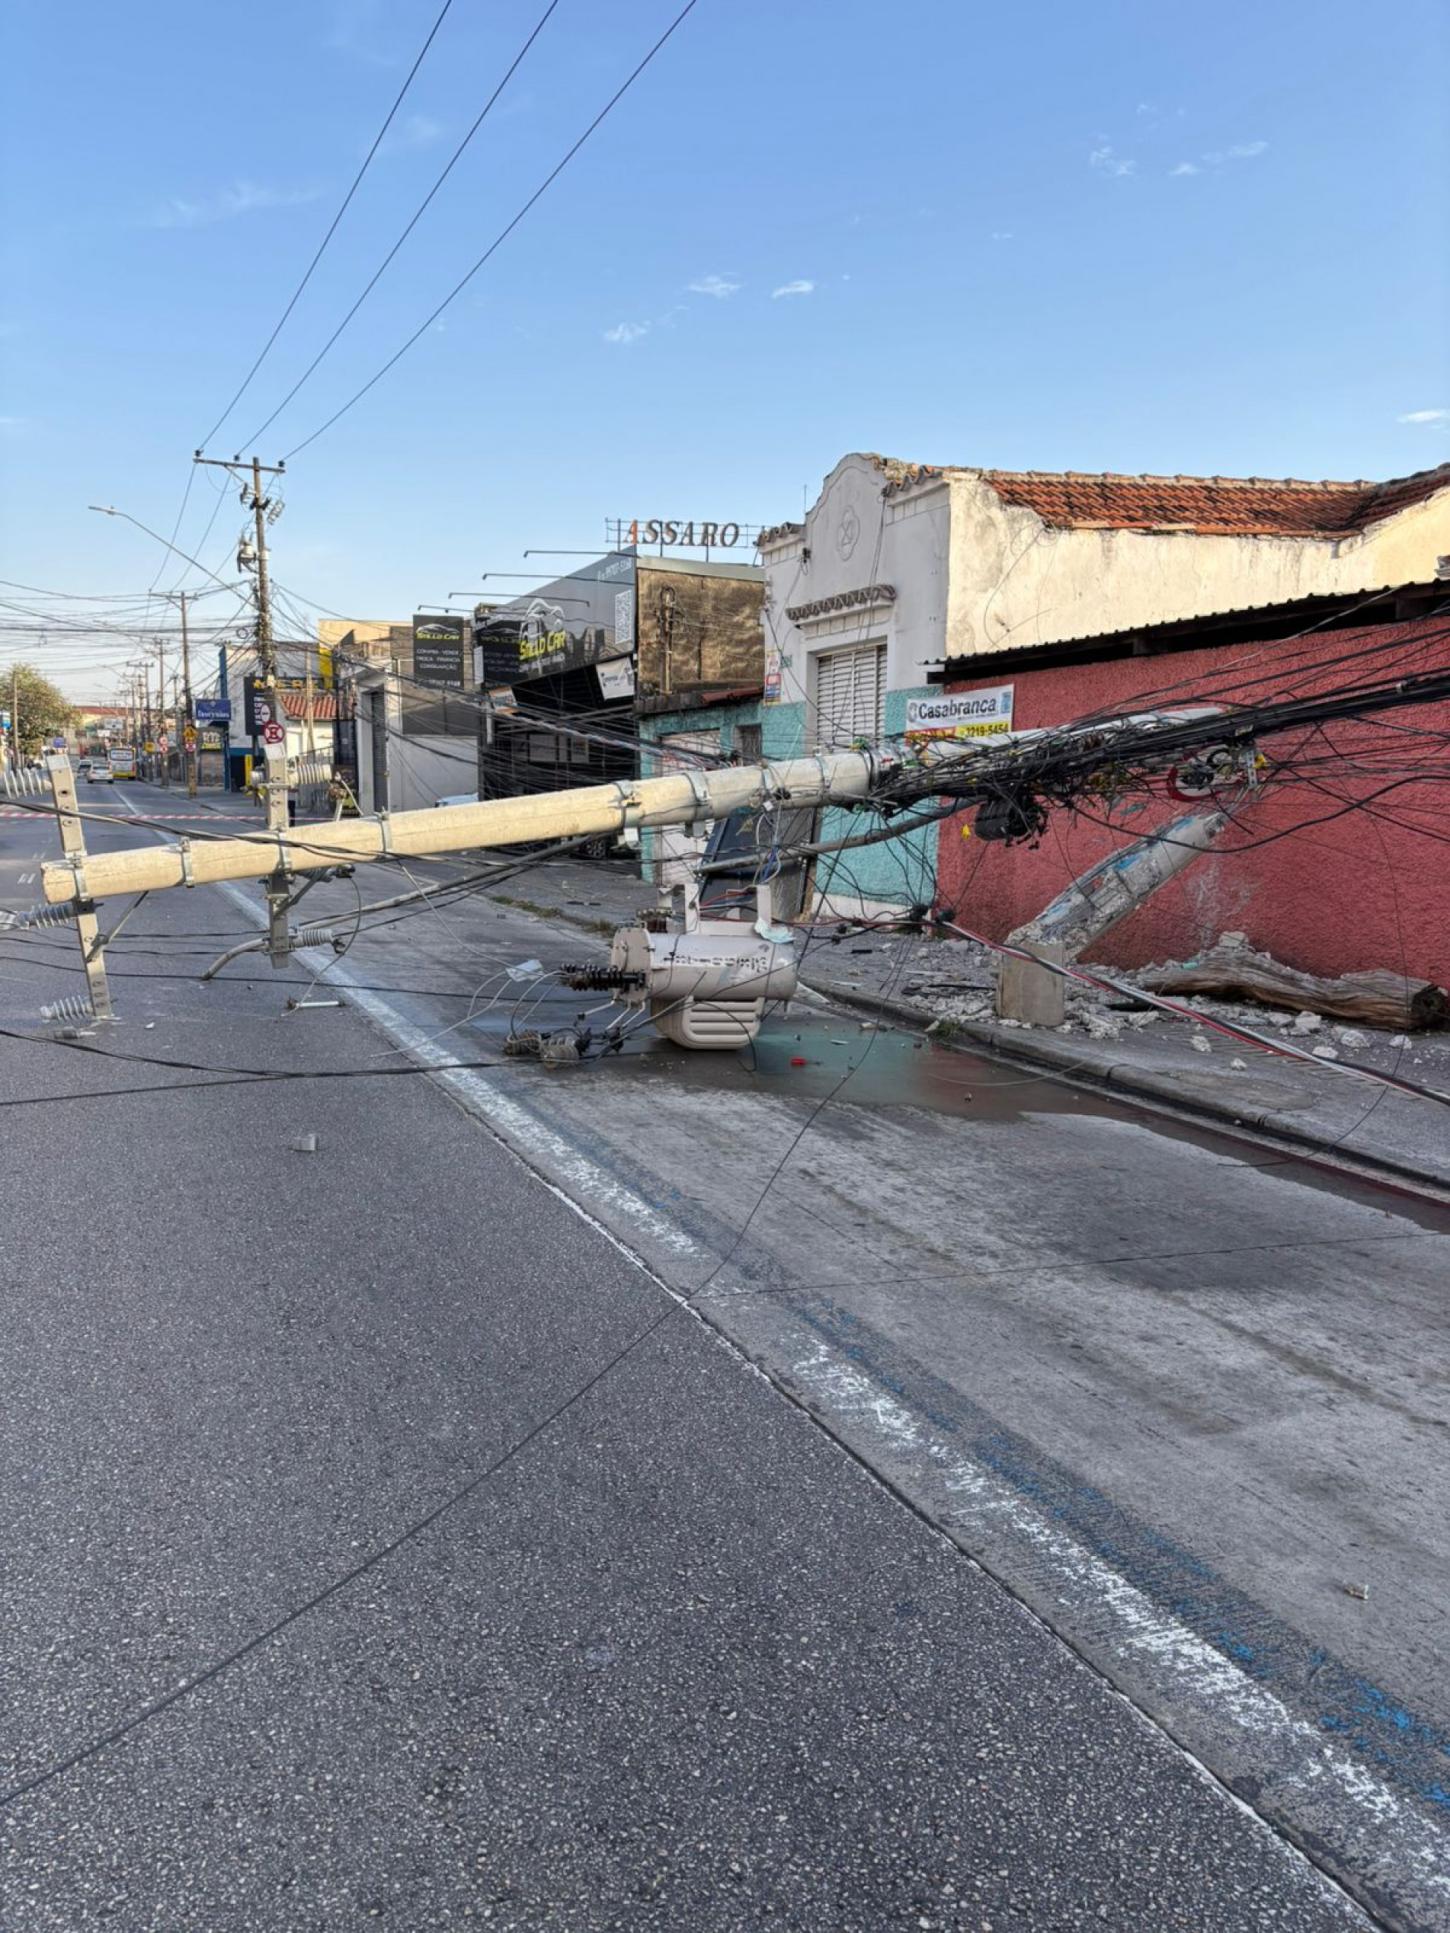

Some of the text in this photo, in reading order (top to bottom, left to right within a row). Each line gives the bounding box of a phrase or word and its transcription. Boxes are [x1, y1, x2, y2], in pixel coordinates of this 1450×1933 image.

[623, 519, 740, 547] ASSARO
[547, 630, 566, 652] CAR
[918, 698, 997, 719] Casabranca
